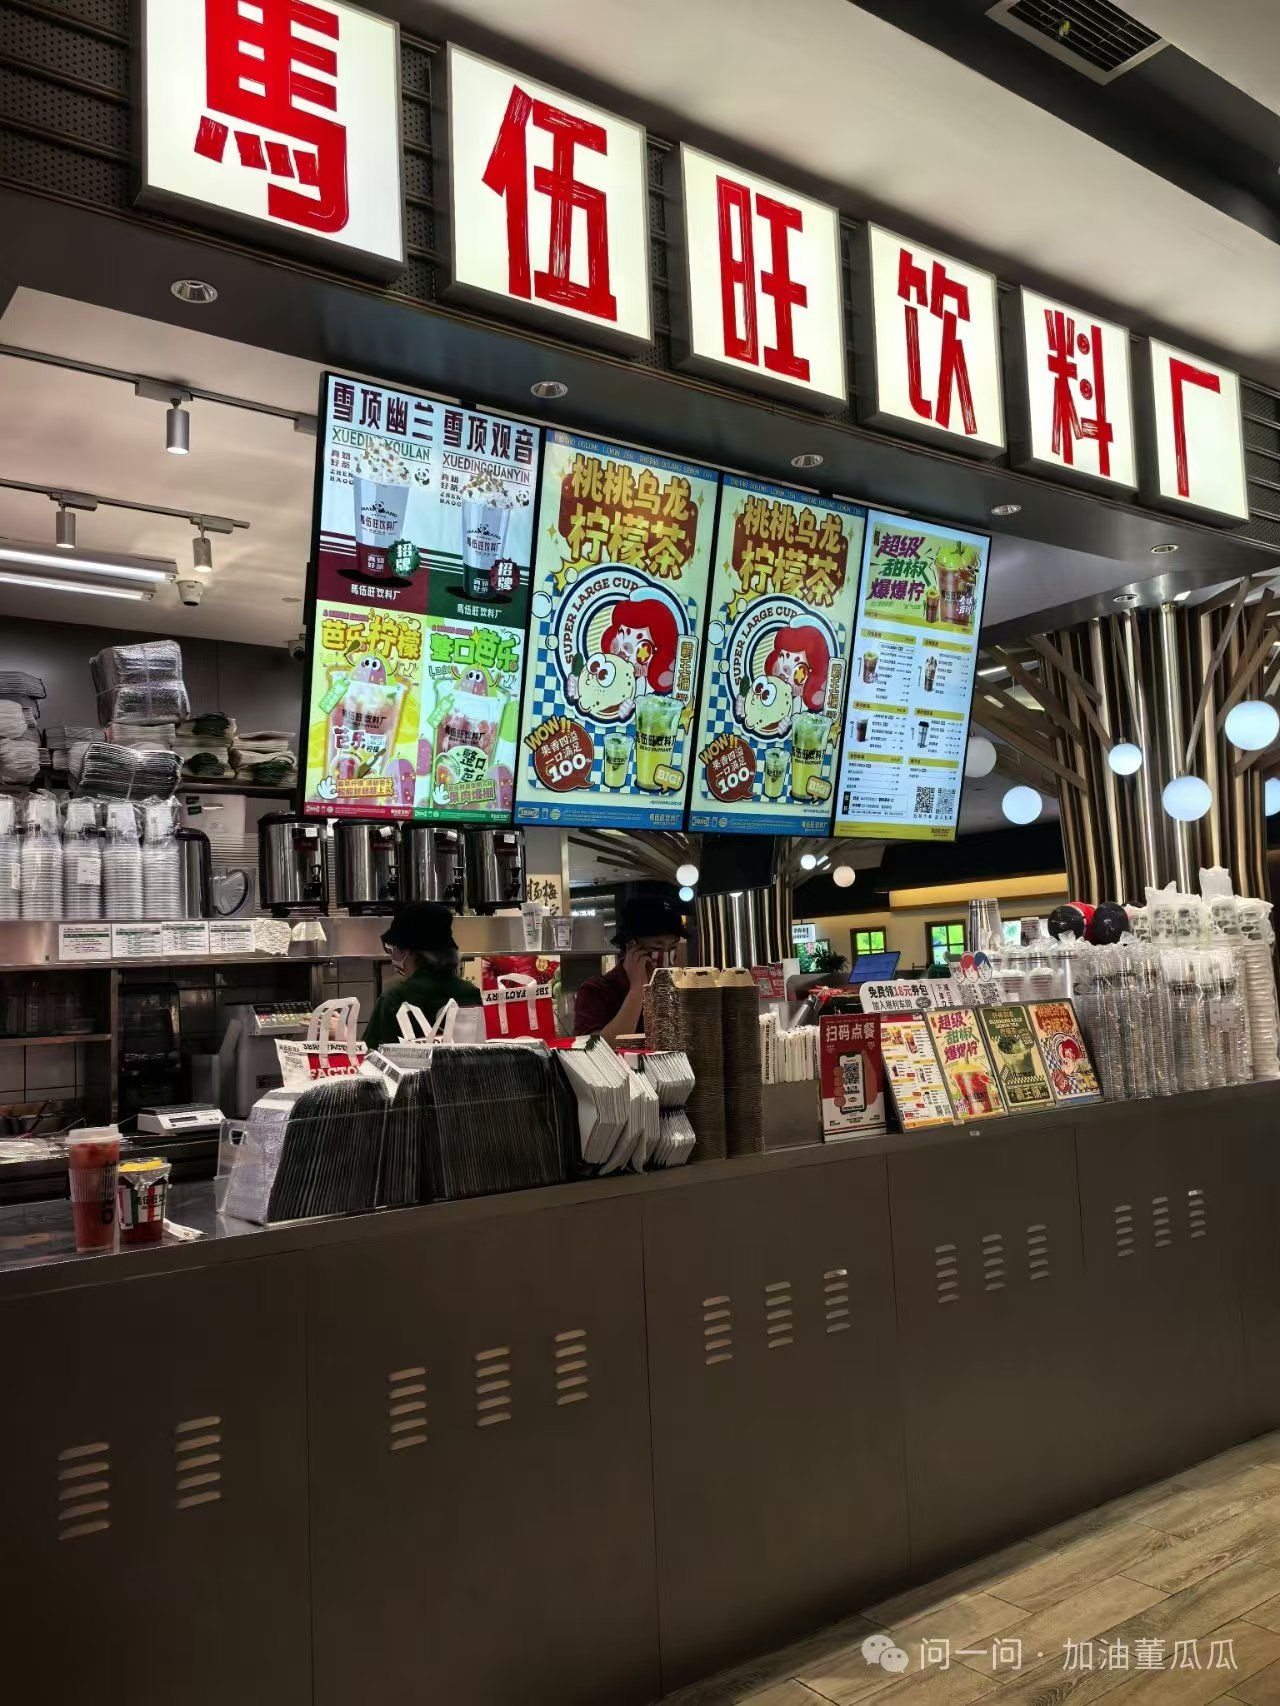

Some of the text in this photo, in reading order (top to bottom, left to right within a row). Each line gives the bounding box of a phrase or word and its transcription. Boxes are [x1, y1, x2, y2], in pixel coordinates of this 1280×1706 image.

[194, 0, 1221, 498] 馬伍旺饮料厂
[333, 381, 434, 441] 雪顶幽兰
[443, 409, 533, 465] 雪顶观音
[572, 453, 691, 521] 桃桃乌龙
[743, 495, 843, 554] 桃桃乌龙
[566, 502, 686, 580] 柠檬茶
[875, 532, 926, 561] 超级
[496, 562, 513, 591] 招牌
[738, 540, 838, 608] 柠檬茶
[879, 558, 932, 587] 甜椒
[351, 583, 401, 600] 馬伍旺饮料厂
[865, 578, 926, 602] 爆爆柠
[457, 603, 502, 618] 馬伍旺饮料厂
[563, 576, 640, 665] SUPER LARGE CUP
[429, 627, 520, 673] 整口芭乐
[733, 605, 802, 686] SUPER LARGE CUP
[541, 730, 579, 756] 果香四溢
[545, 741, 582, 765] 一口满足
[712, 746, 745, 770] 果香四溢
[716, 757, 747, 777] 一口满足
[485, 990, 527, 1001] FACTRY
[868, 984, 929, 998] 免费领18元券包
[826, 1022, 875, 1042] 扫码点餐
[937, 1011, 967, 1034] 超级
[945, 1026, 979, 1044] 甜椒
[944, 1040, 978, 1064] 爆爆柠
